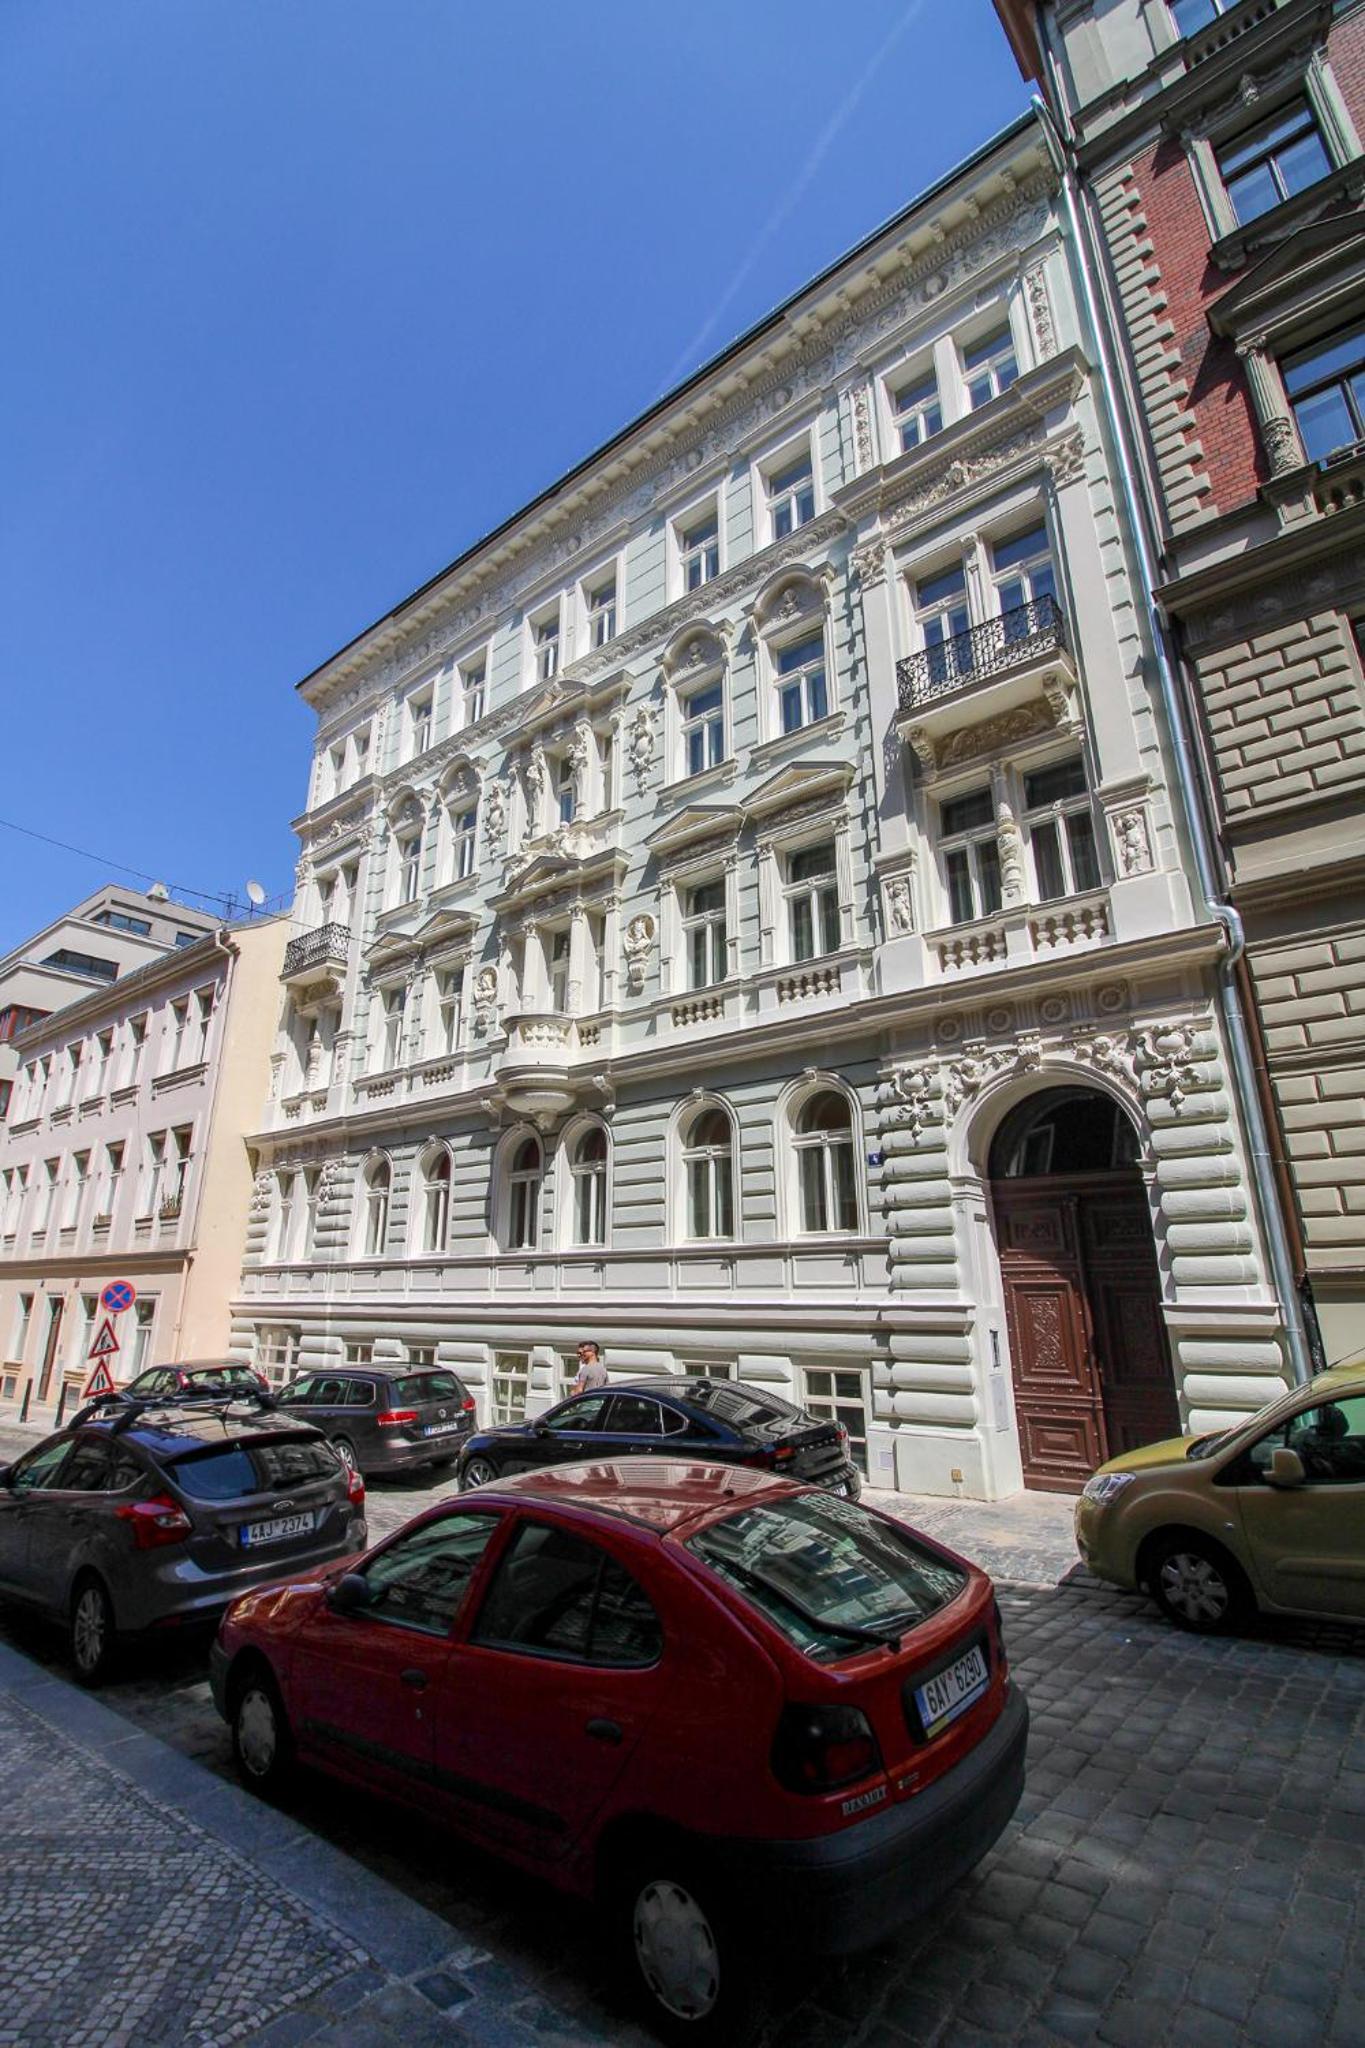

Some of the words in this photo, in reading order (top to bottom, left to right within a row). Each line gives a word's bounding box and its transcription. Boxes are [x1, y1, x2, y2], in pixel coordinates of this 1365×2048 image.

[251, 1522, 273, 1540] 4AJ
[281, 1515, 309, 1534] 2374
[926, 1675, 951, 1714] 6AY
[954, 1652, 981, 1692] 6290
